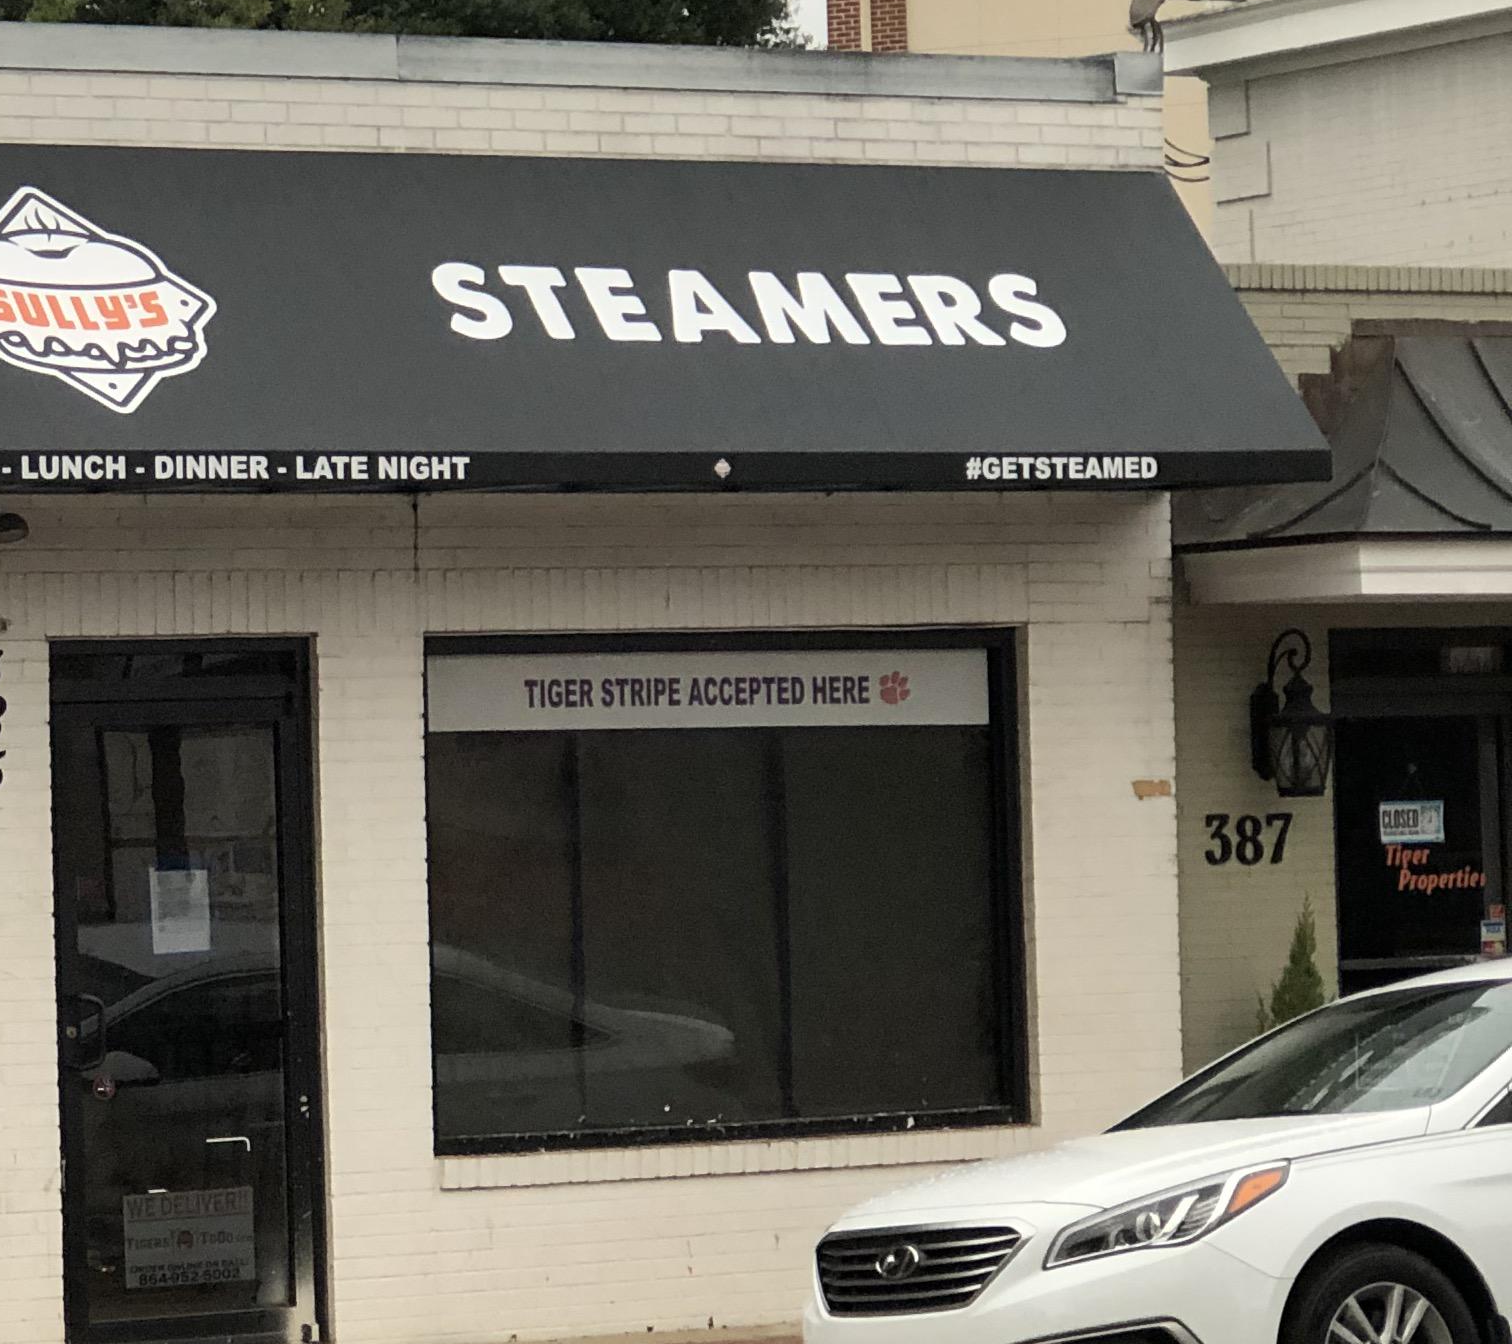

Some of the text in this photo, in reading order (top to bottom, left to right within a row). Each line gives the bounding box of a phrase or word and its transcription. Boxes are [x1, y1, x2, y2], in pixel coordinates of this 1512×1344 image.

[431, 261, 1067, 349] STEAMERS
[21, 455, 126, 480] LUNCH
[154, 455, 270, 480] DINNER
[295, 455, 369, 480] LATE
[378, 455, 470, 481] NIGHT
[966, 456, 1158, 480] #GETSTEAMED
[523, 675, 871, 709] TIGER STRIPE ACCEPTED HERE
[1382, 809, 1419, 829] CLOSED
[1204, 812, 1293, 866] 387
[1385, 845, 1430, 869] Tiger
[126, 1198, 156, 1219] WE
